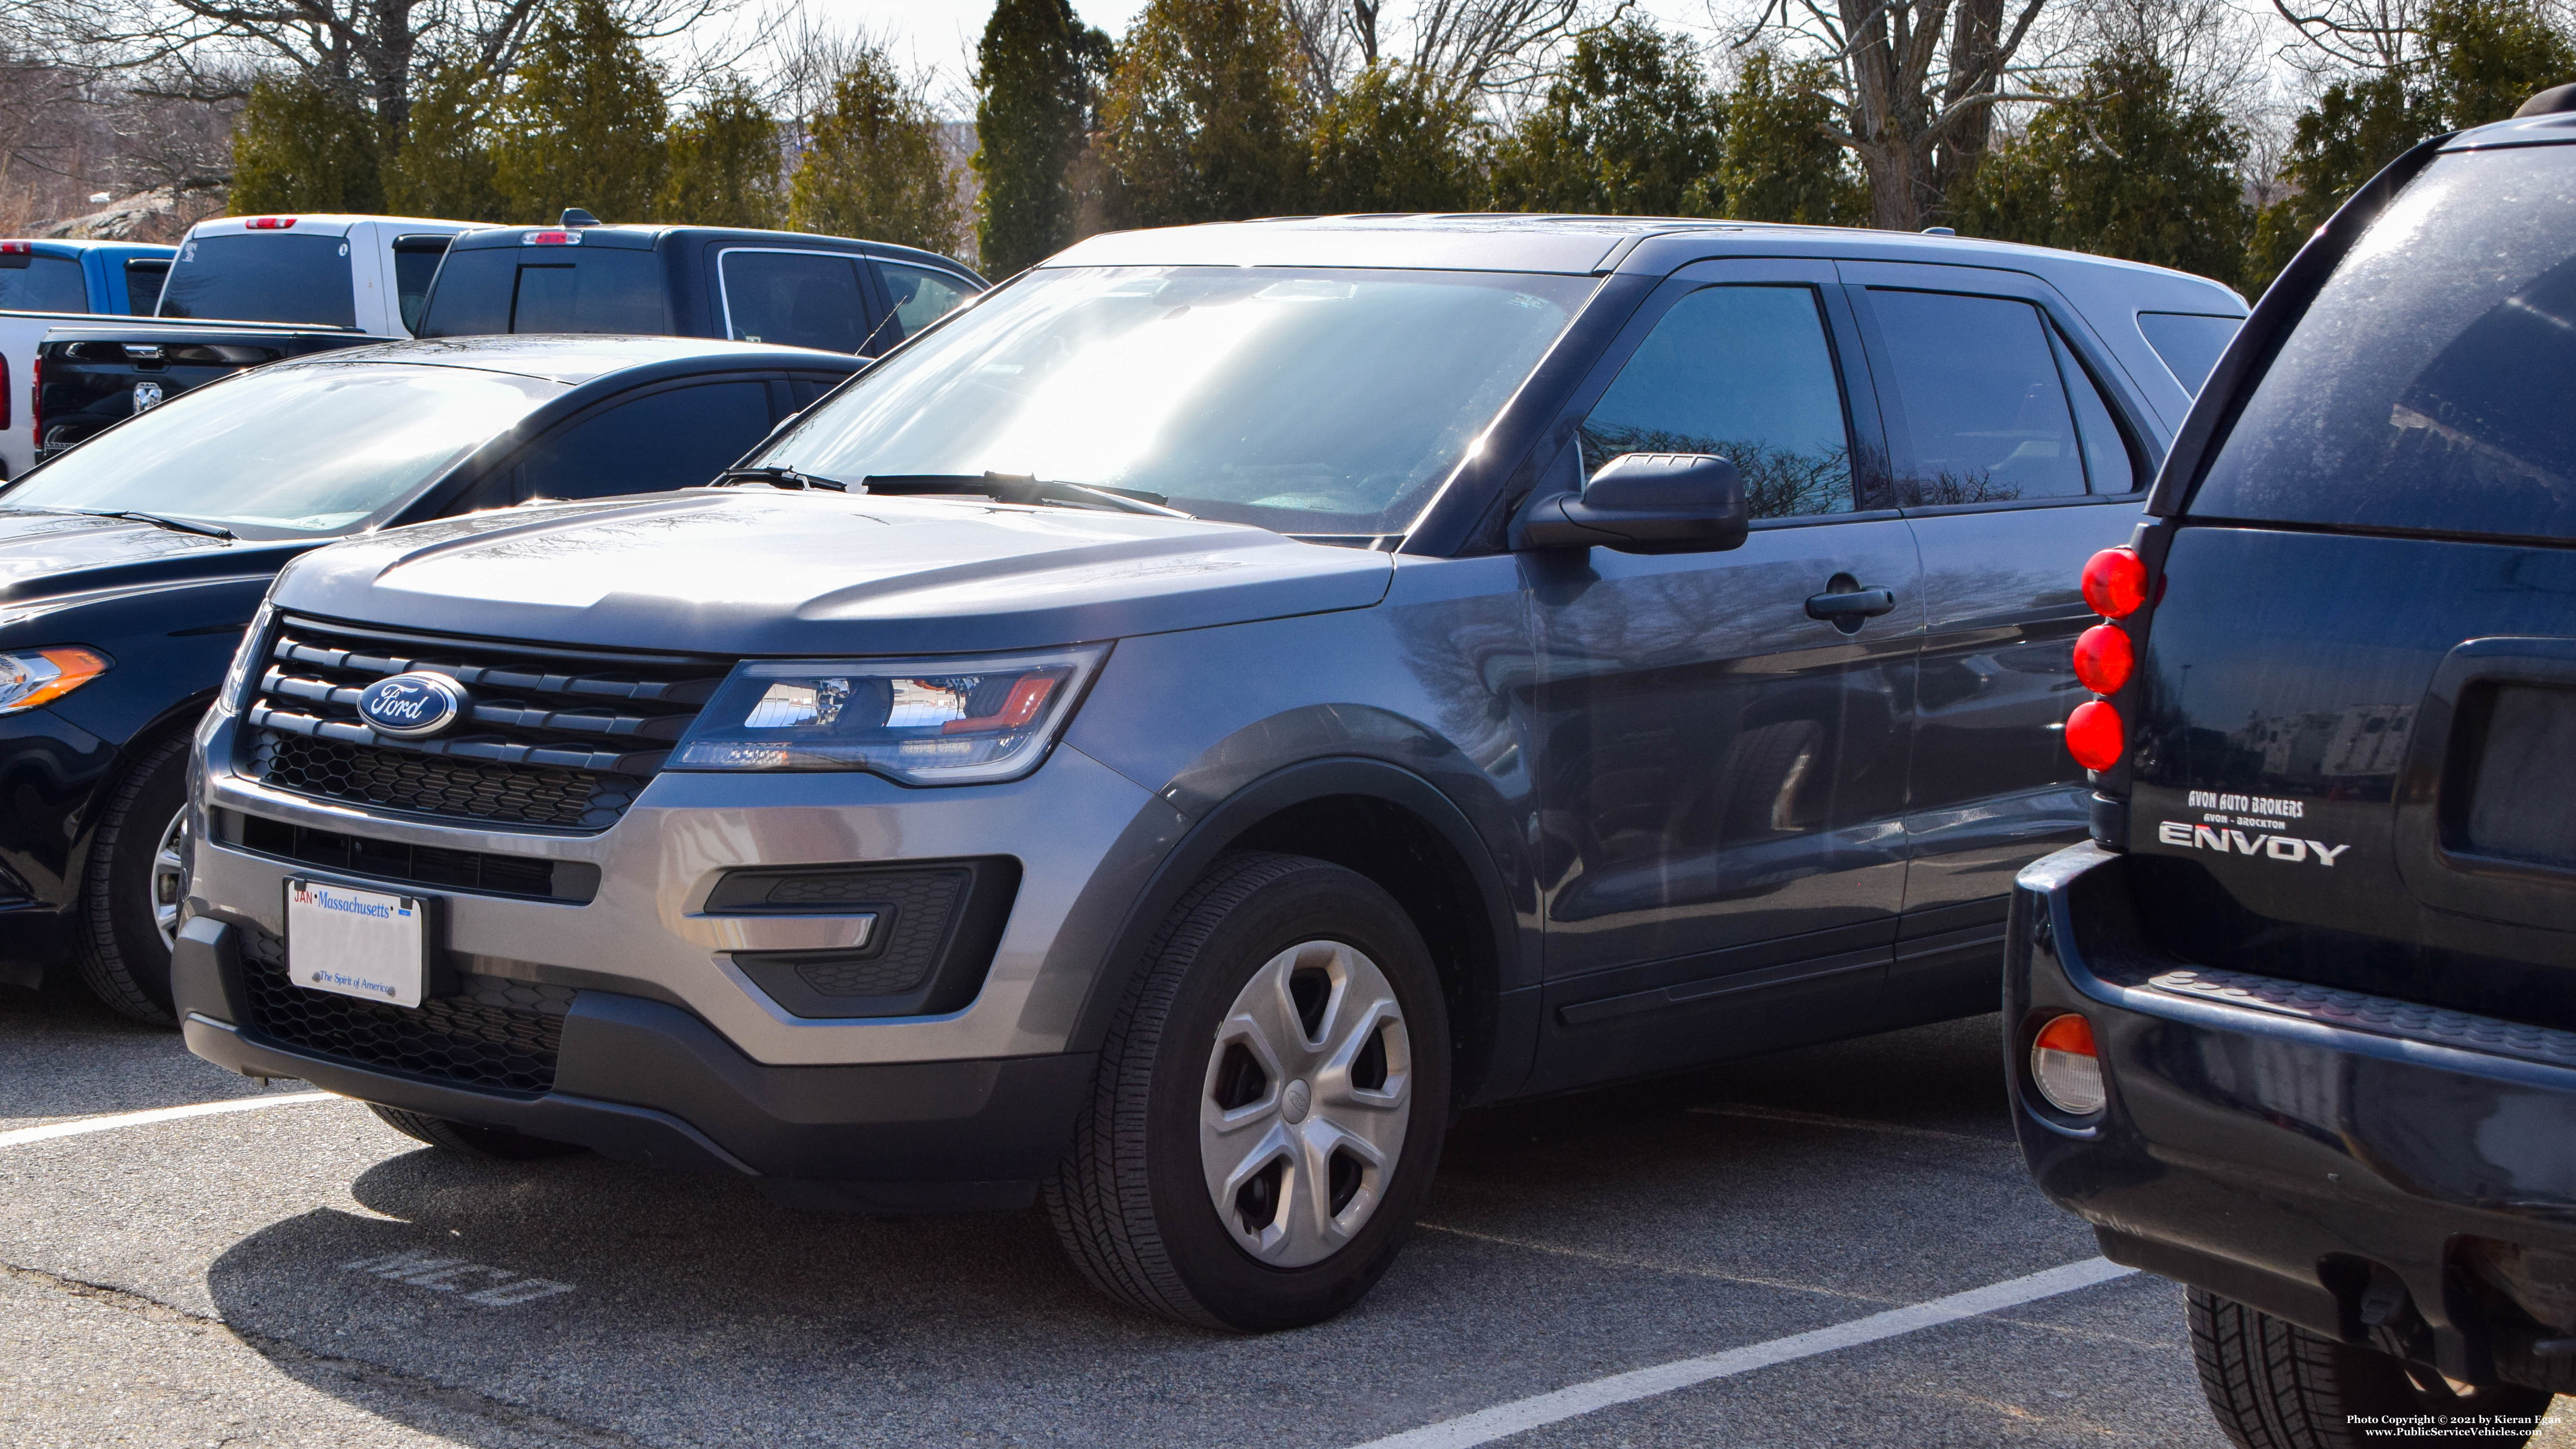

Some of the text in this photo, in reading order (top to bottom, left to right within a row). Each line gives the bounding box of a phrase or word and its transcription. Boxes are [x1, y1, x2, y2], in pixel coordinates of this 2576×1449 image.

[371, 684, 429, 719] Ford
[2188, 790, 2303, 818] AVON AUTO BROKERS
[2204, 813, 2228, 823] AVON
[2237, 816, 2285, 829] BROCKTON
[2159, 820, 2351, 866] ENVOY
[294, 890, 312, 904] JAN
[318, 890, 389, 919] Massachusetts
[320, 970, 389, 992] The Spirit of America
